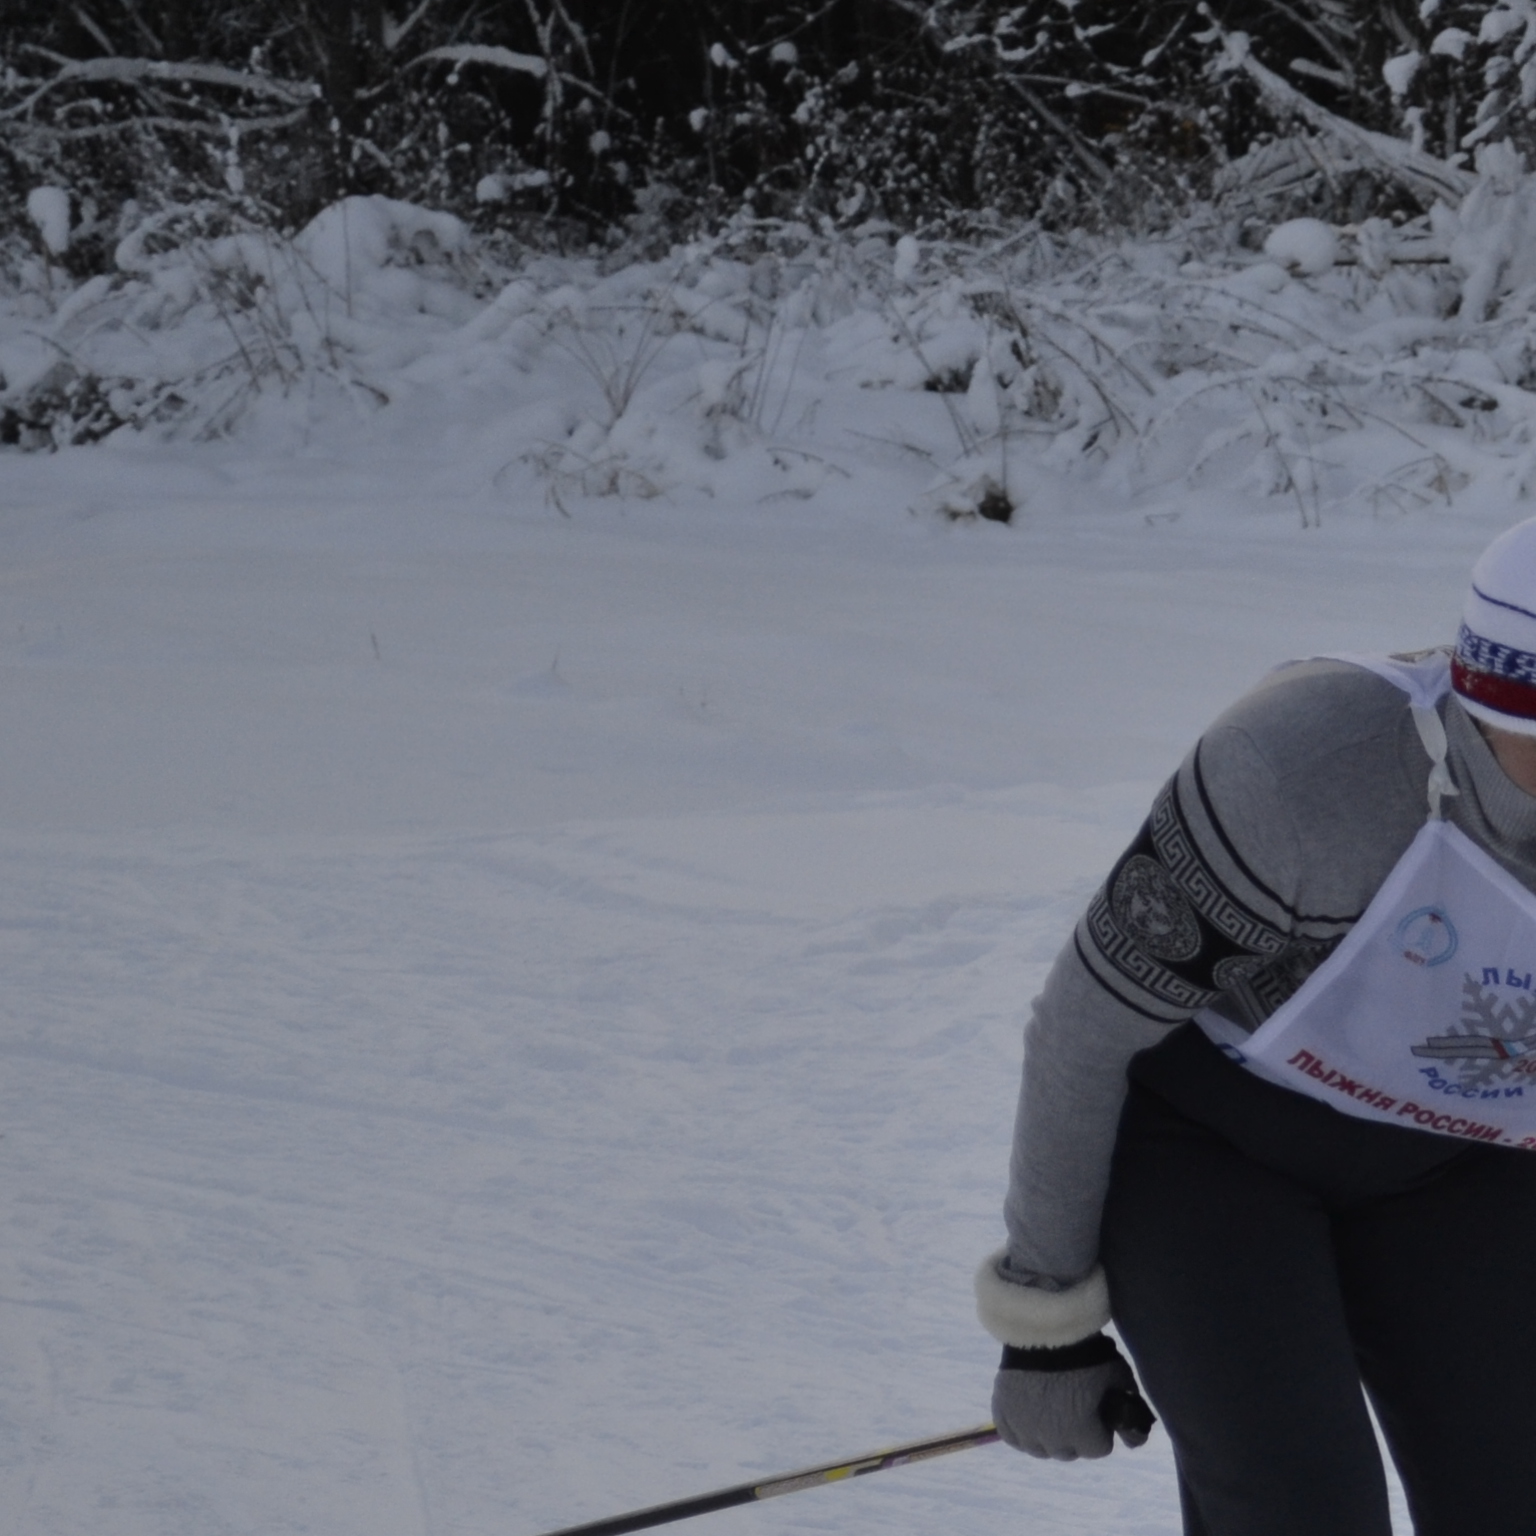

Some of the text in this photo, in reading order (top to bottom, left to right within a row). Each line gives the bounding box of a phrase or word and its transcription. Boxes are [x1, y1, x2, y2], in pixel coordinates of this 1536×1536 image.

[1287, 1049, 1398, 1111] ЛЫЖНЯ
[1397, 1101, 1503, 1142] РОССИИ
[1419, 1066, 1523, 1098] РОССИИ
